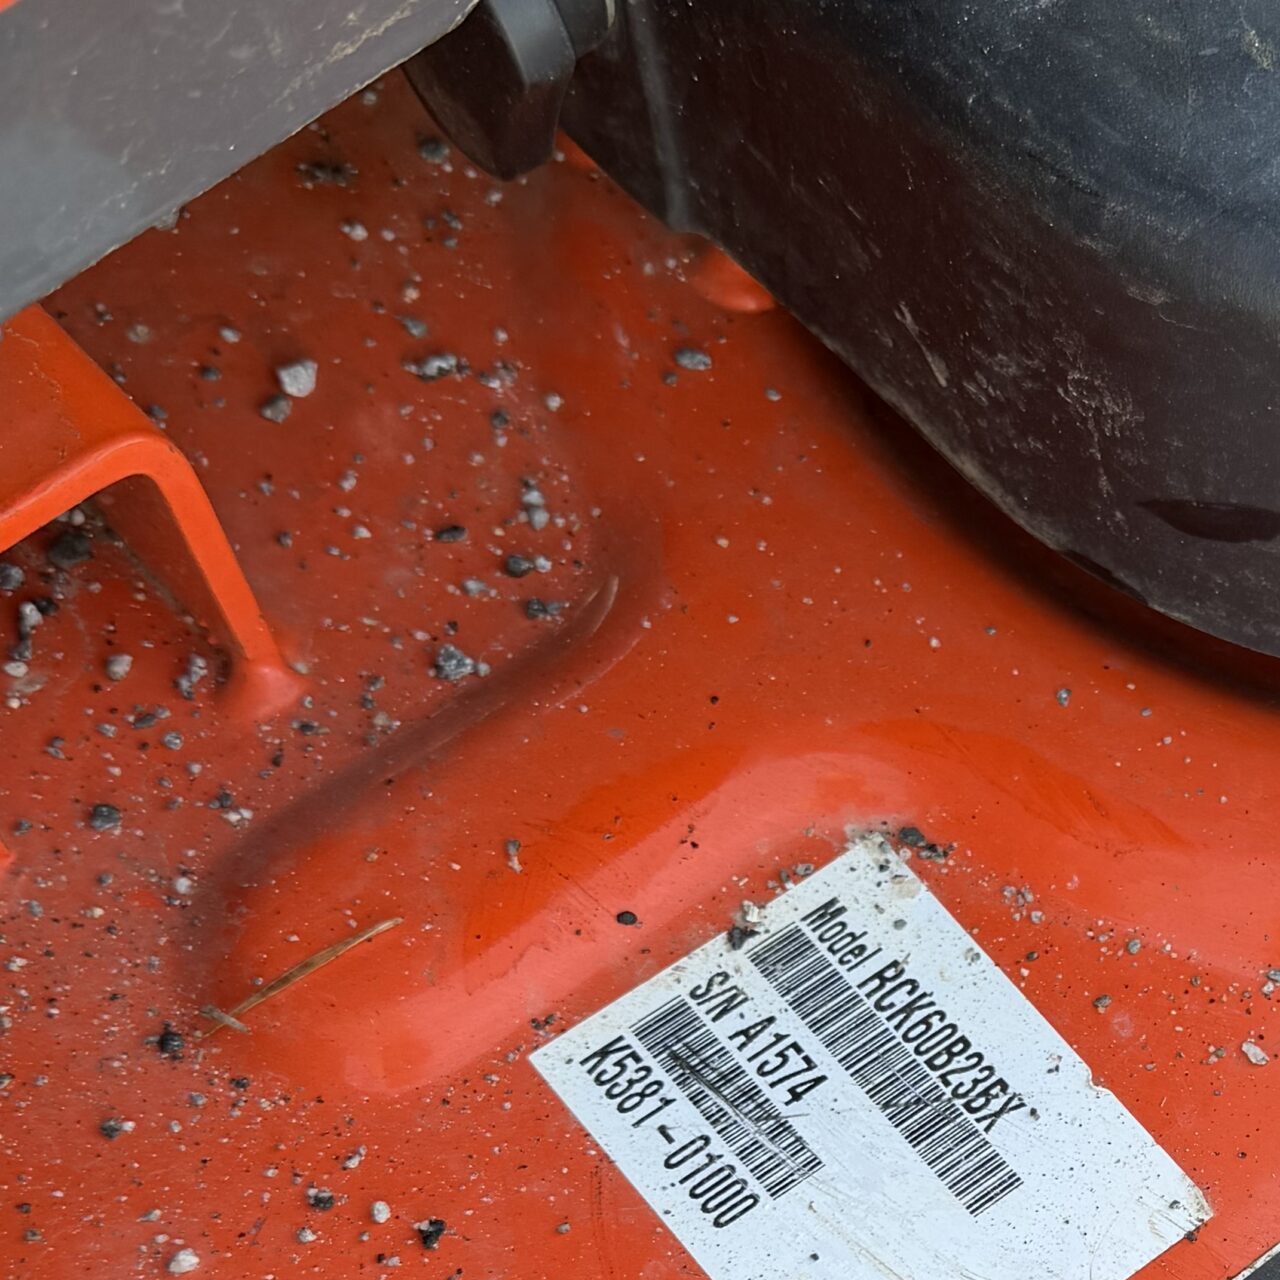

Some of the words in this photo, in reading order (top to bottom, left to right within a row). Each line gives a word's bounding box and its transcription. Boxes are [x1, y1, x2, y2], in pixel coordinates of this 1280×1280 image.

[689, 971, 749, 1023] S/N
[728, 1015, 828, 1106] A1574
[801, 897, 882, 972] Model
[857, 960, 1027, 1134] RCK60B23BX
[579, 1035, 760, 1228] K5381-01000
